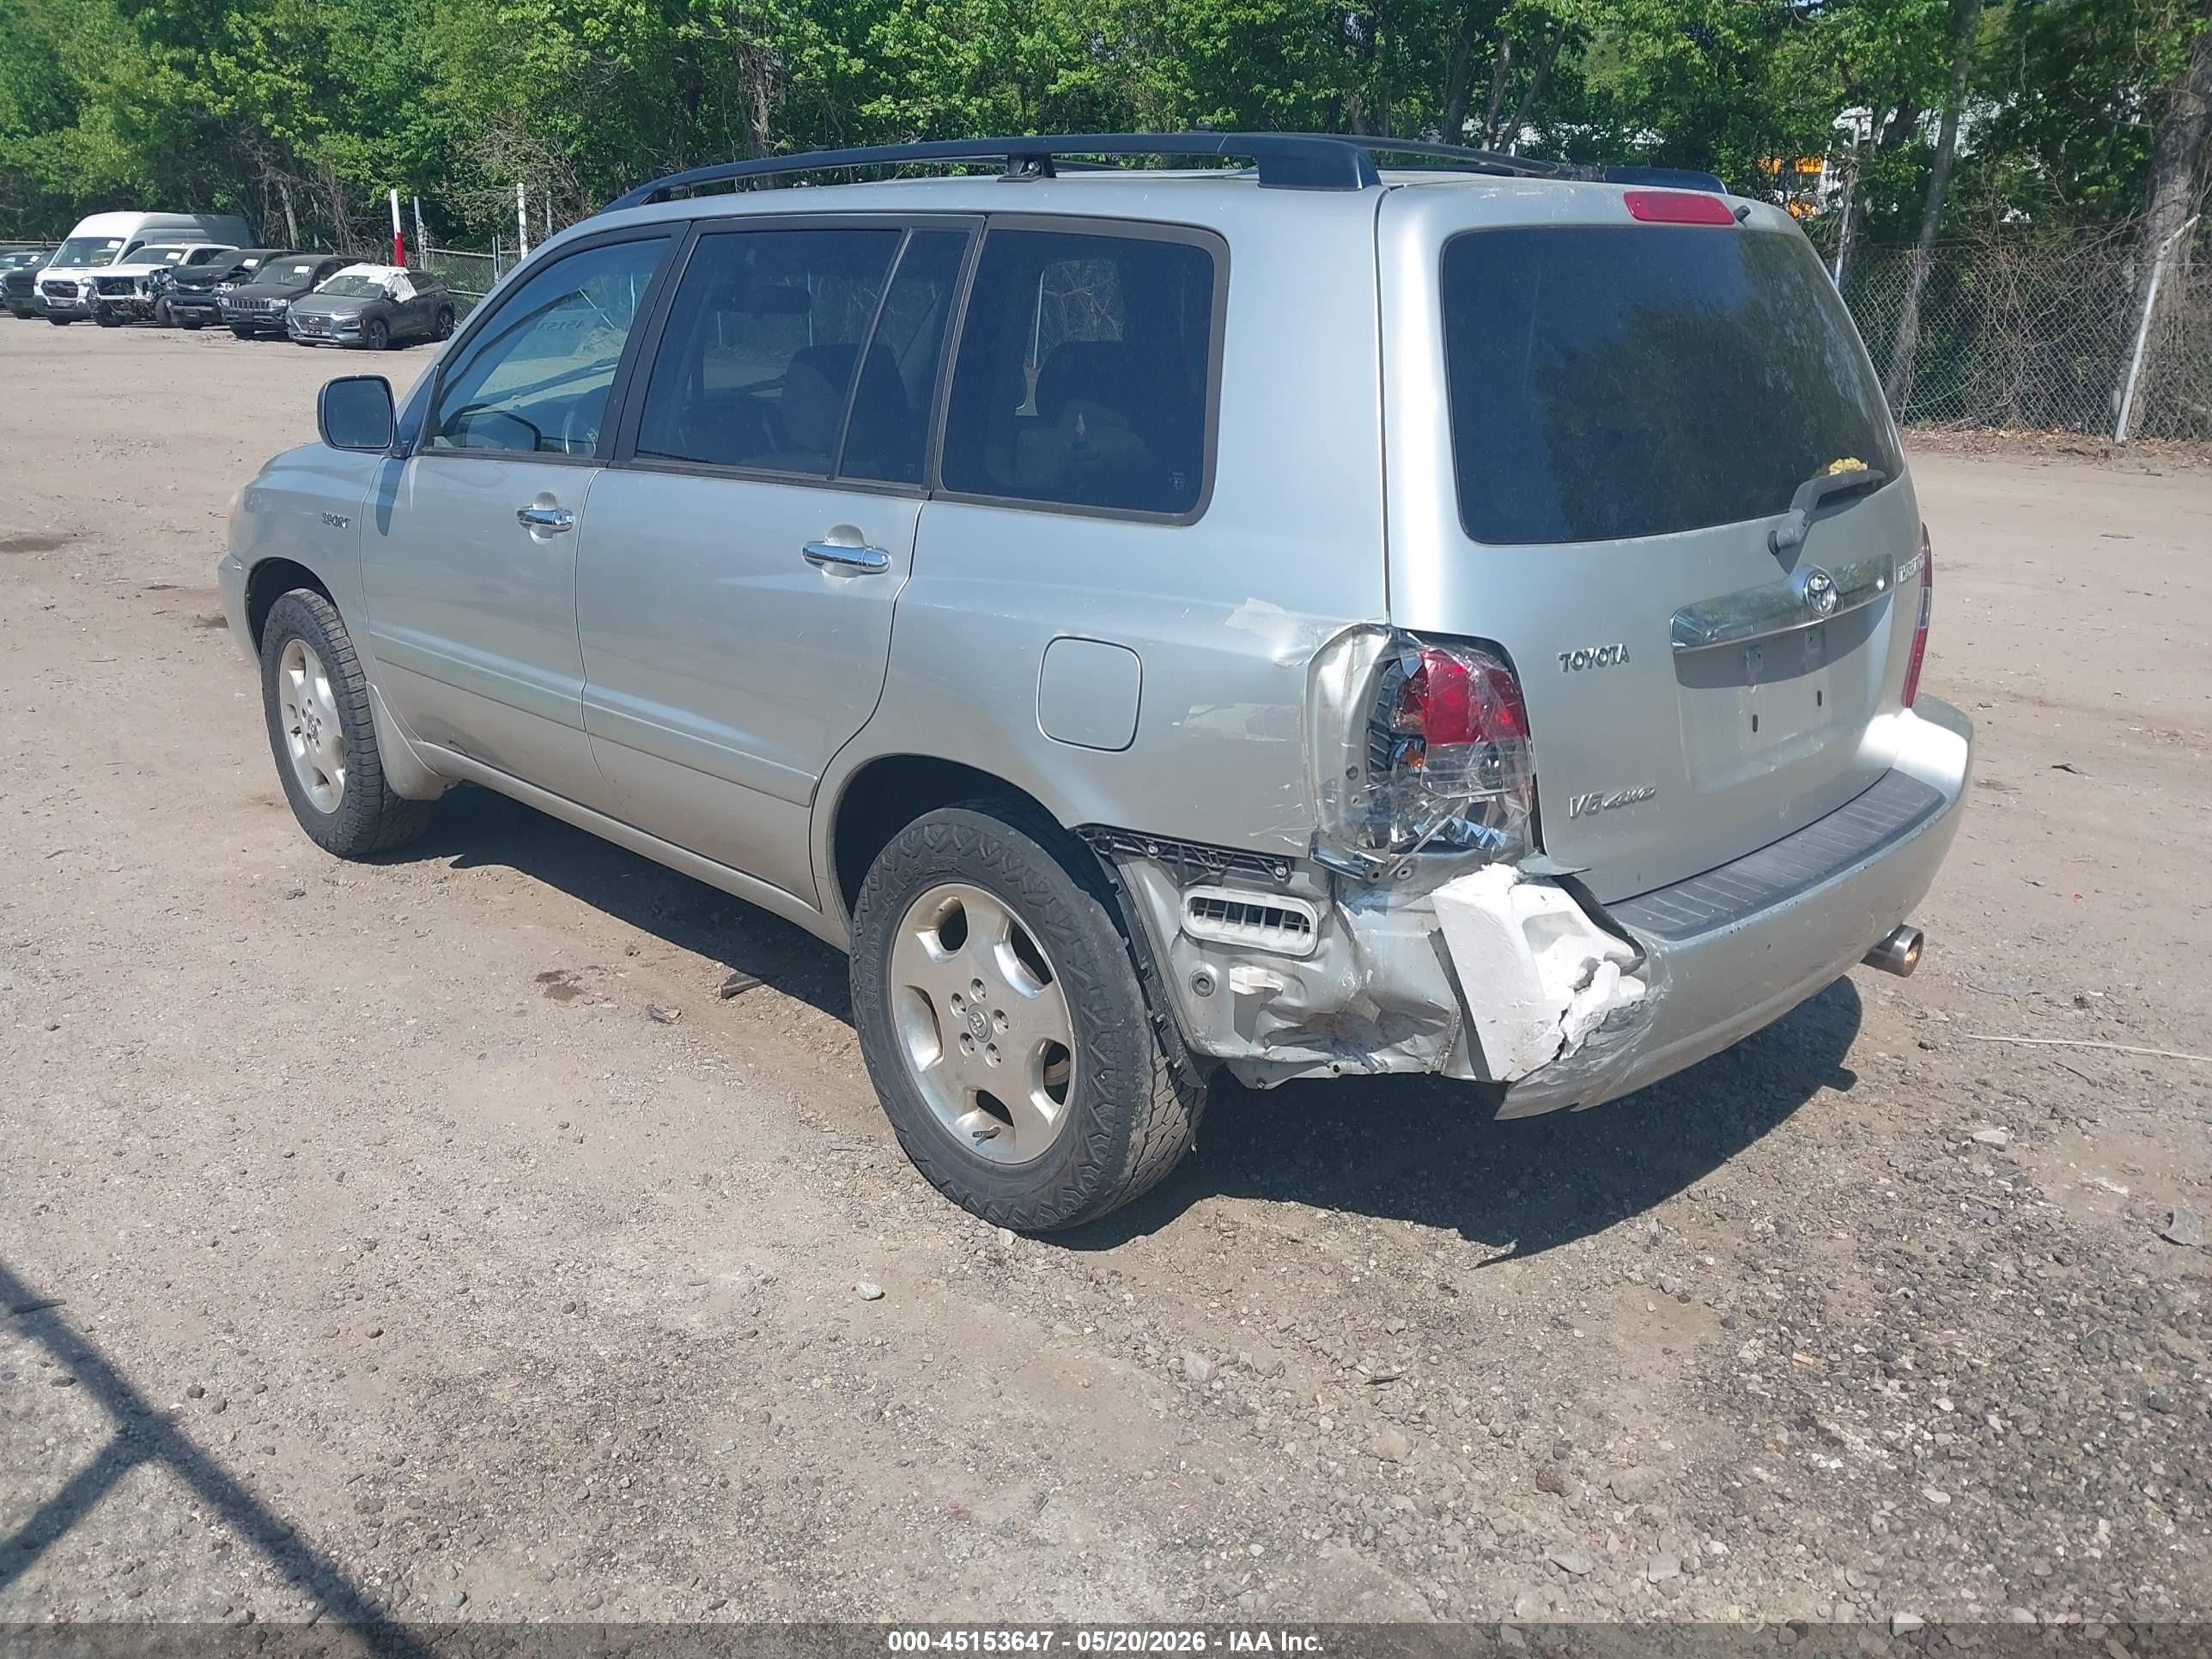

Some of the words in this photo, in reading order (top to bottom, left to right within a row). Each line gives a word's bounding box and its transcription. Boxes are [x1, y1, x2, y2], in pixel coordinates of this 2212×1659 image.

[321, 512, 351, 529] SPORT
[1558, 643, 1630, 672] TOYOTA
[1568, 790, 1603, 819] V6
